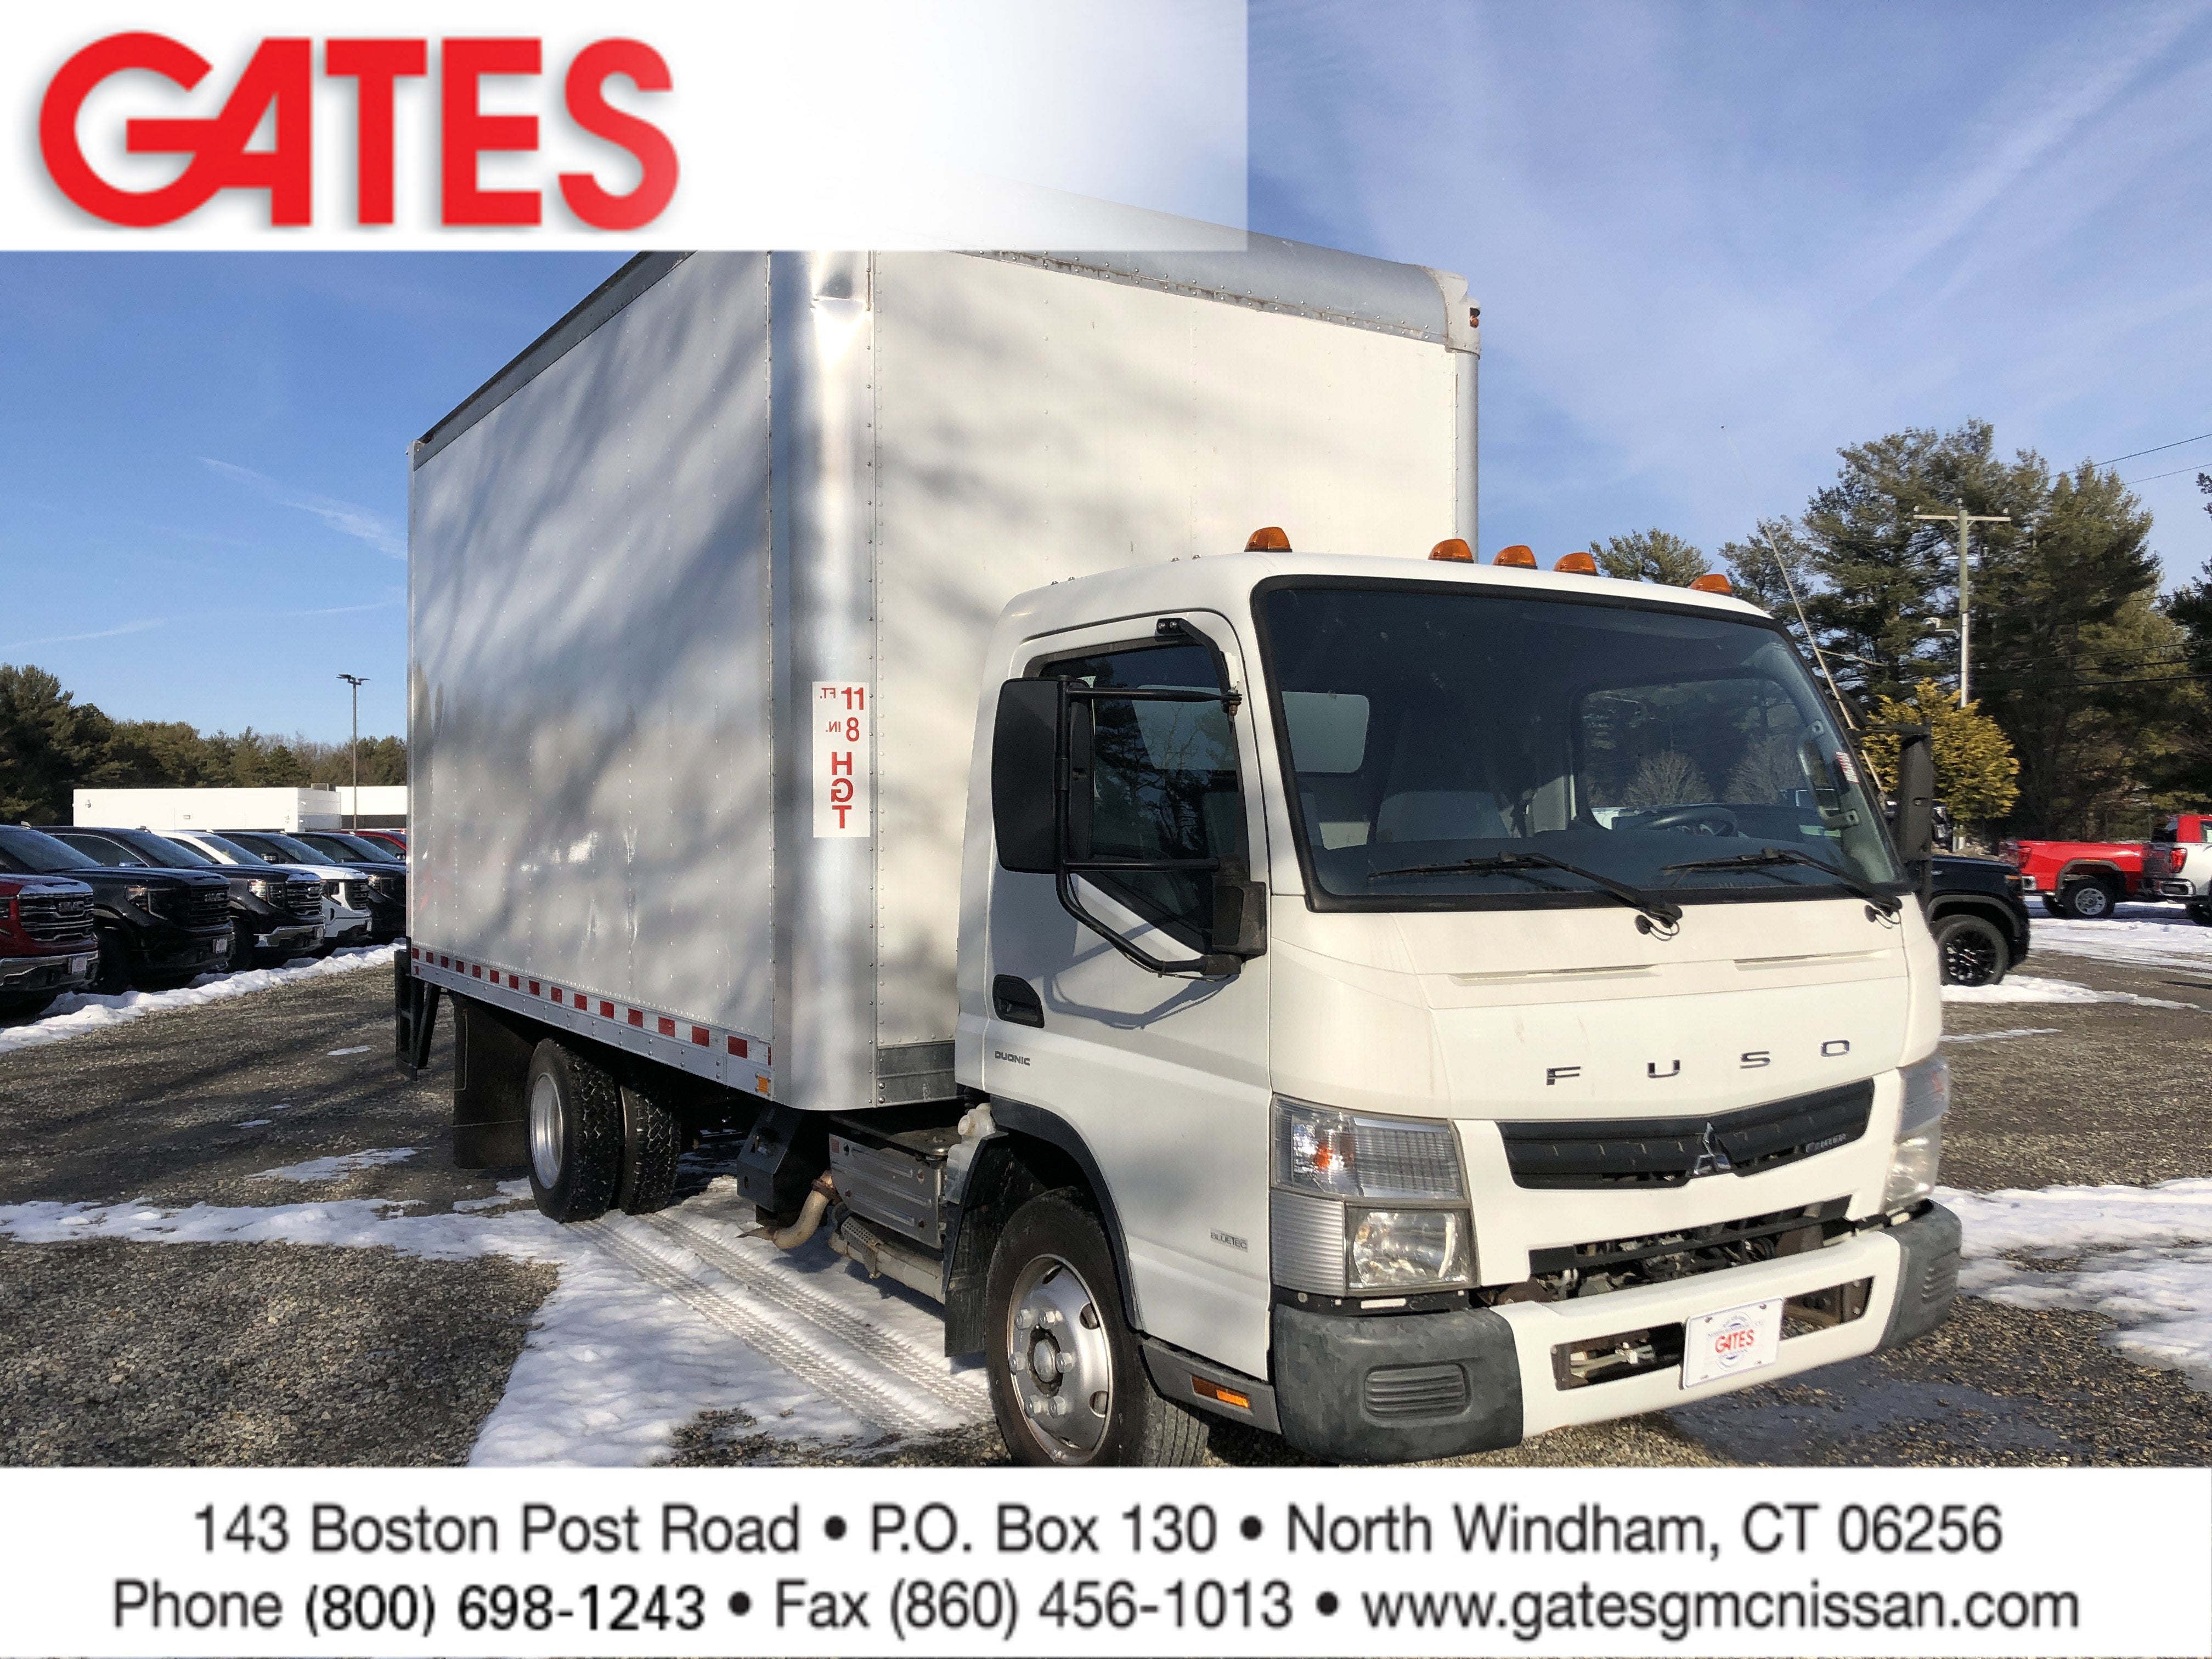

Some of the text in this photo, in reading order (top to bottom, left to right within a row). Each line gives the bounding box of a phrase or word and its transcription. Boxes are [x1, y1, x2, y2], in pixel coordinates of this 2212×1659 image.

[994, 1051, 1030, 1066] DUONIC
[1545, 1039, 1850, 1086] FUSO
[1715, 1329, 1754, 1353] GATES
